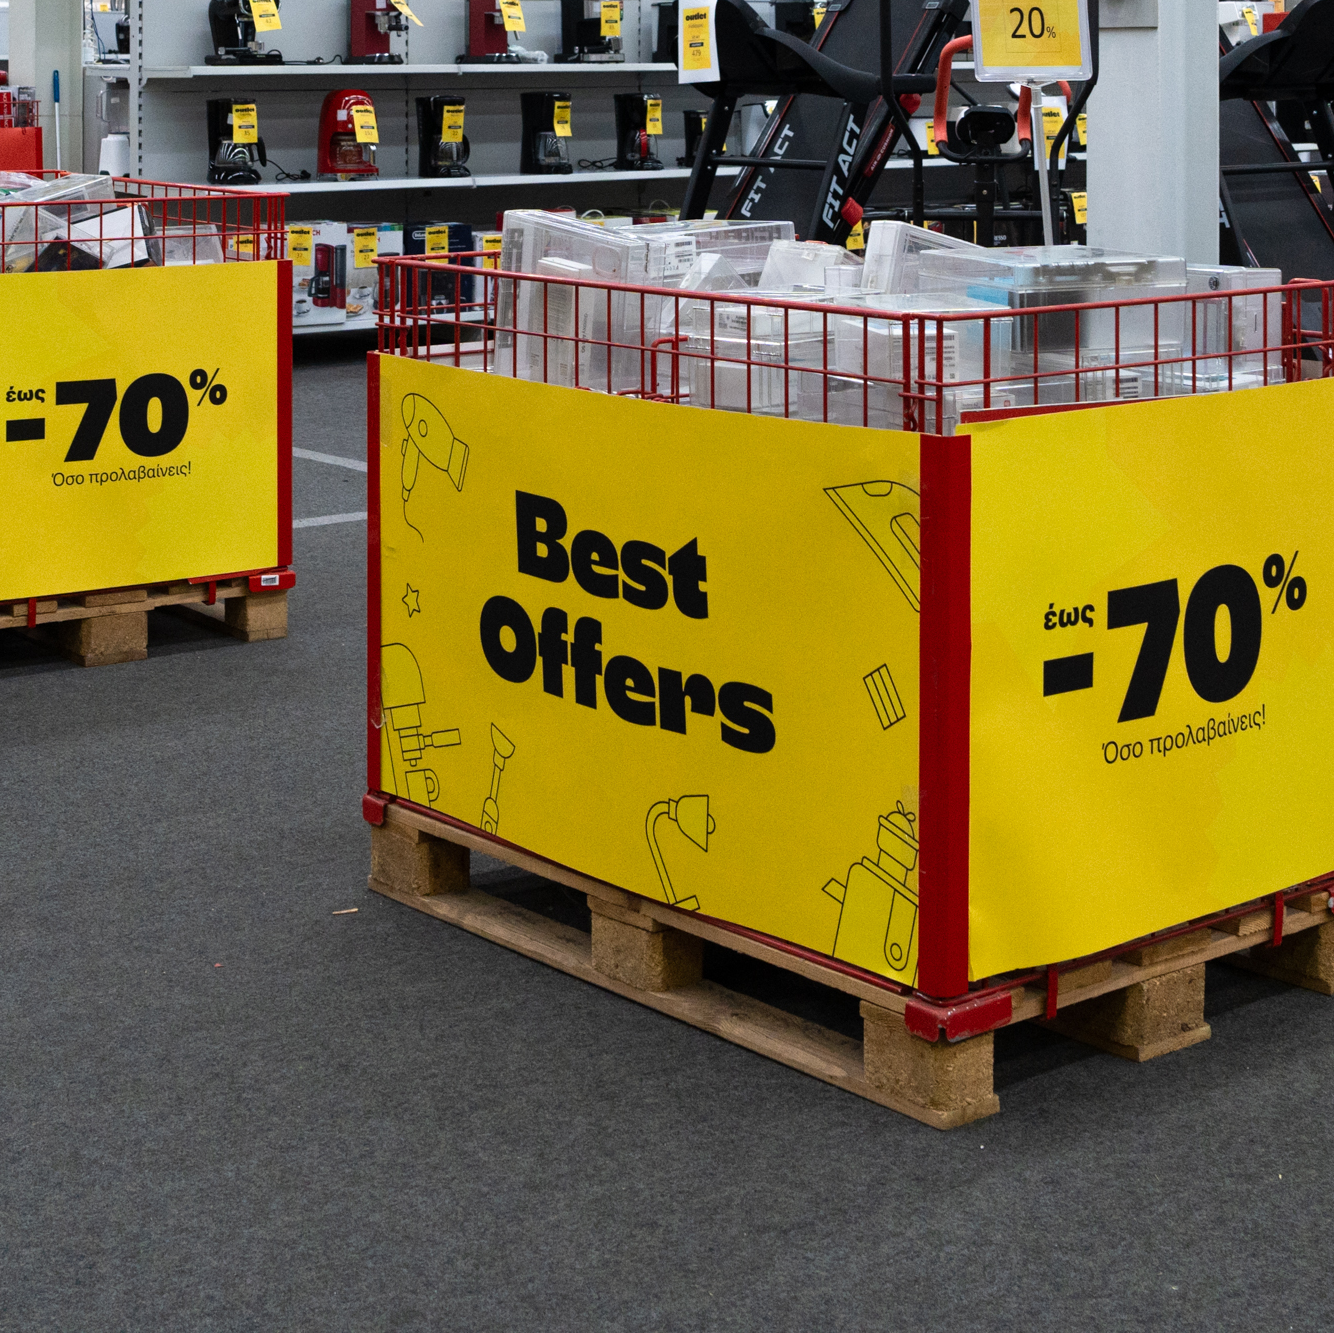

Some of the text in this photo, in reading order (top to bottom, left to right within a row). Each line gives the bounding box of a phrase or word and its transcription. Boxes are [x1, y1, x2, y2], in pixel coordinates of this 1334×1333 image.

[686, 12, 706, 21] outlet
[822, 114, 861, 229] FIT ACT
[741, 175, 768, 217] FIT
[5, 385, 46, 403] έως
[52, 461, 191, 487] Όσο προλαβαίνεις!
[514, 489, 709, 620] Best
[1043, 603, 1096, 631] έως
[479, 594, 777, 755] Offers
[1101, 704, 1267, 764] Όσο προλαβαίνεις!
